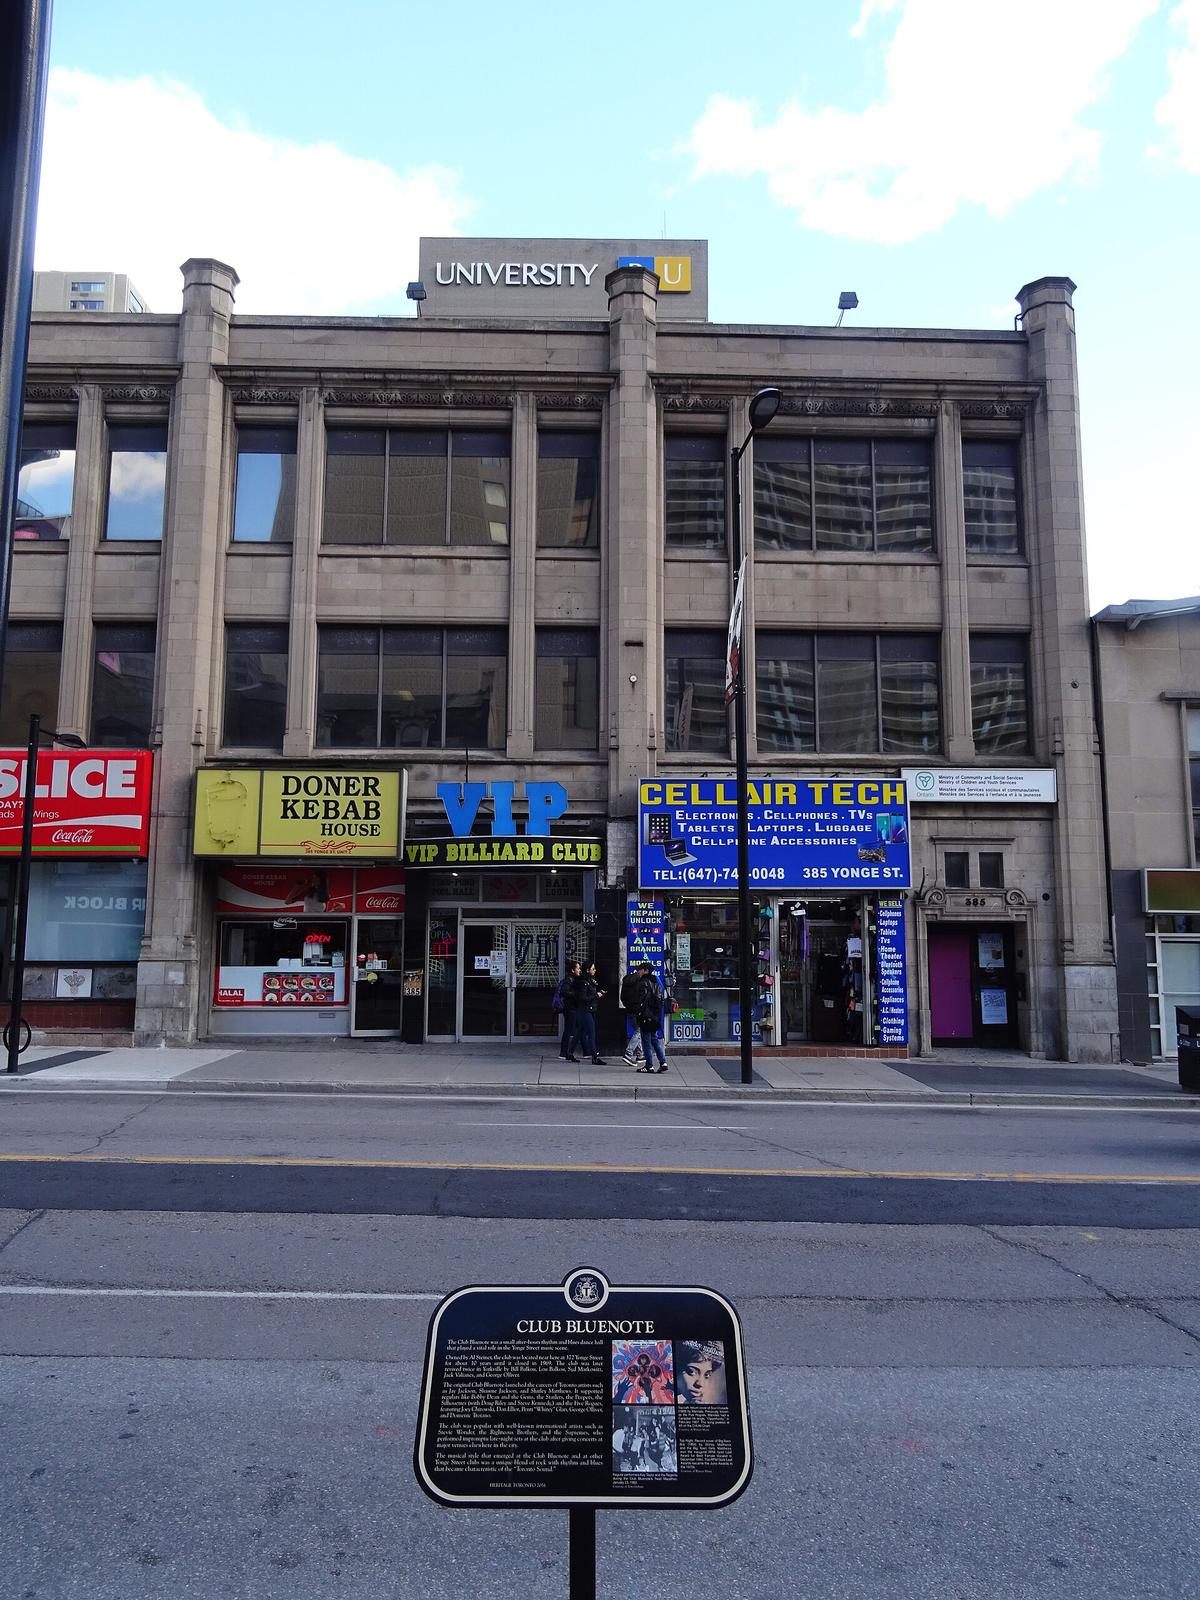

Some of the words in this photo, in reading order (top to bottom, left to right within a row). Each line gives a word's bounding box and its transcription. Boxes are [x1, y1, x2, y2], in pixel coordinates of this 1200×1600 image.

[436, 262, 599, 286] UNIVERSITY
[281, 775, 381, 796] DONER
[807, 783, 905, 805] TECH
[280, 799, 381, 820] KEBAB
[436, 781, 569, 836] VIP
[320, 823, 381, 837] HOUSE
[405, 844, 439, 863] VIP
[446, 842, 545, 862] BILLIARD
[551, 843, 602, 862] CLUB
[653, 867, 785, 883] TEL:(647)-74-0048
[802, 867, 828, 879] 385
[831, 867, 880, 879] YONGE
[882, 867, 904, 879] ST.
[965, 898, 986, 906] 385
[305, 935, 331, 943] OPEN
[634, 937, 658, 945] ALL
[516, 1320, 562, 1333] CLUB
[566, 1320, 655, 1334] BLUENOTE
